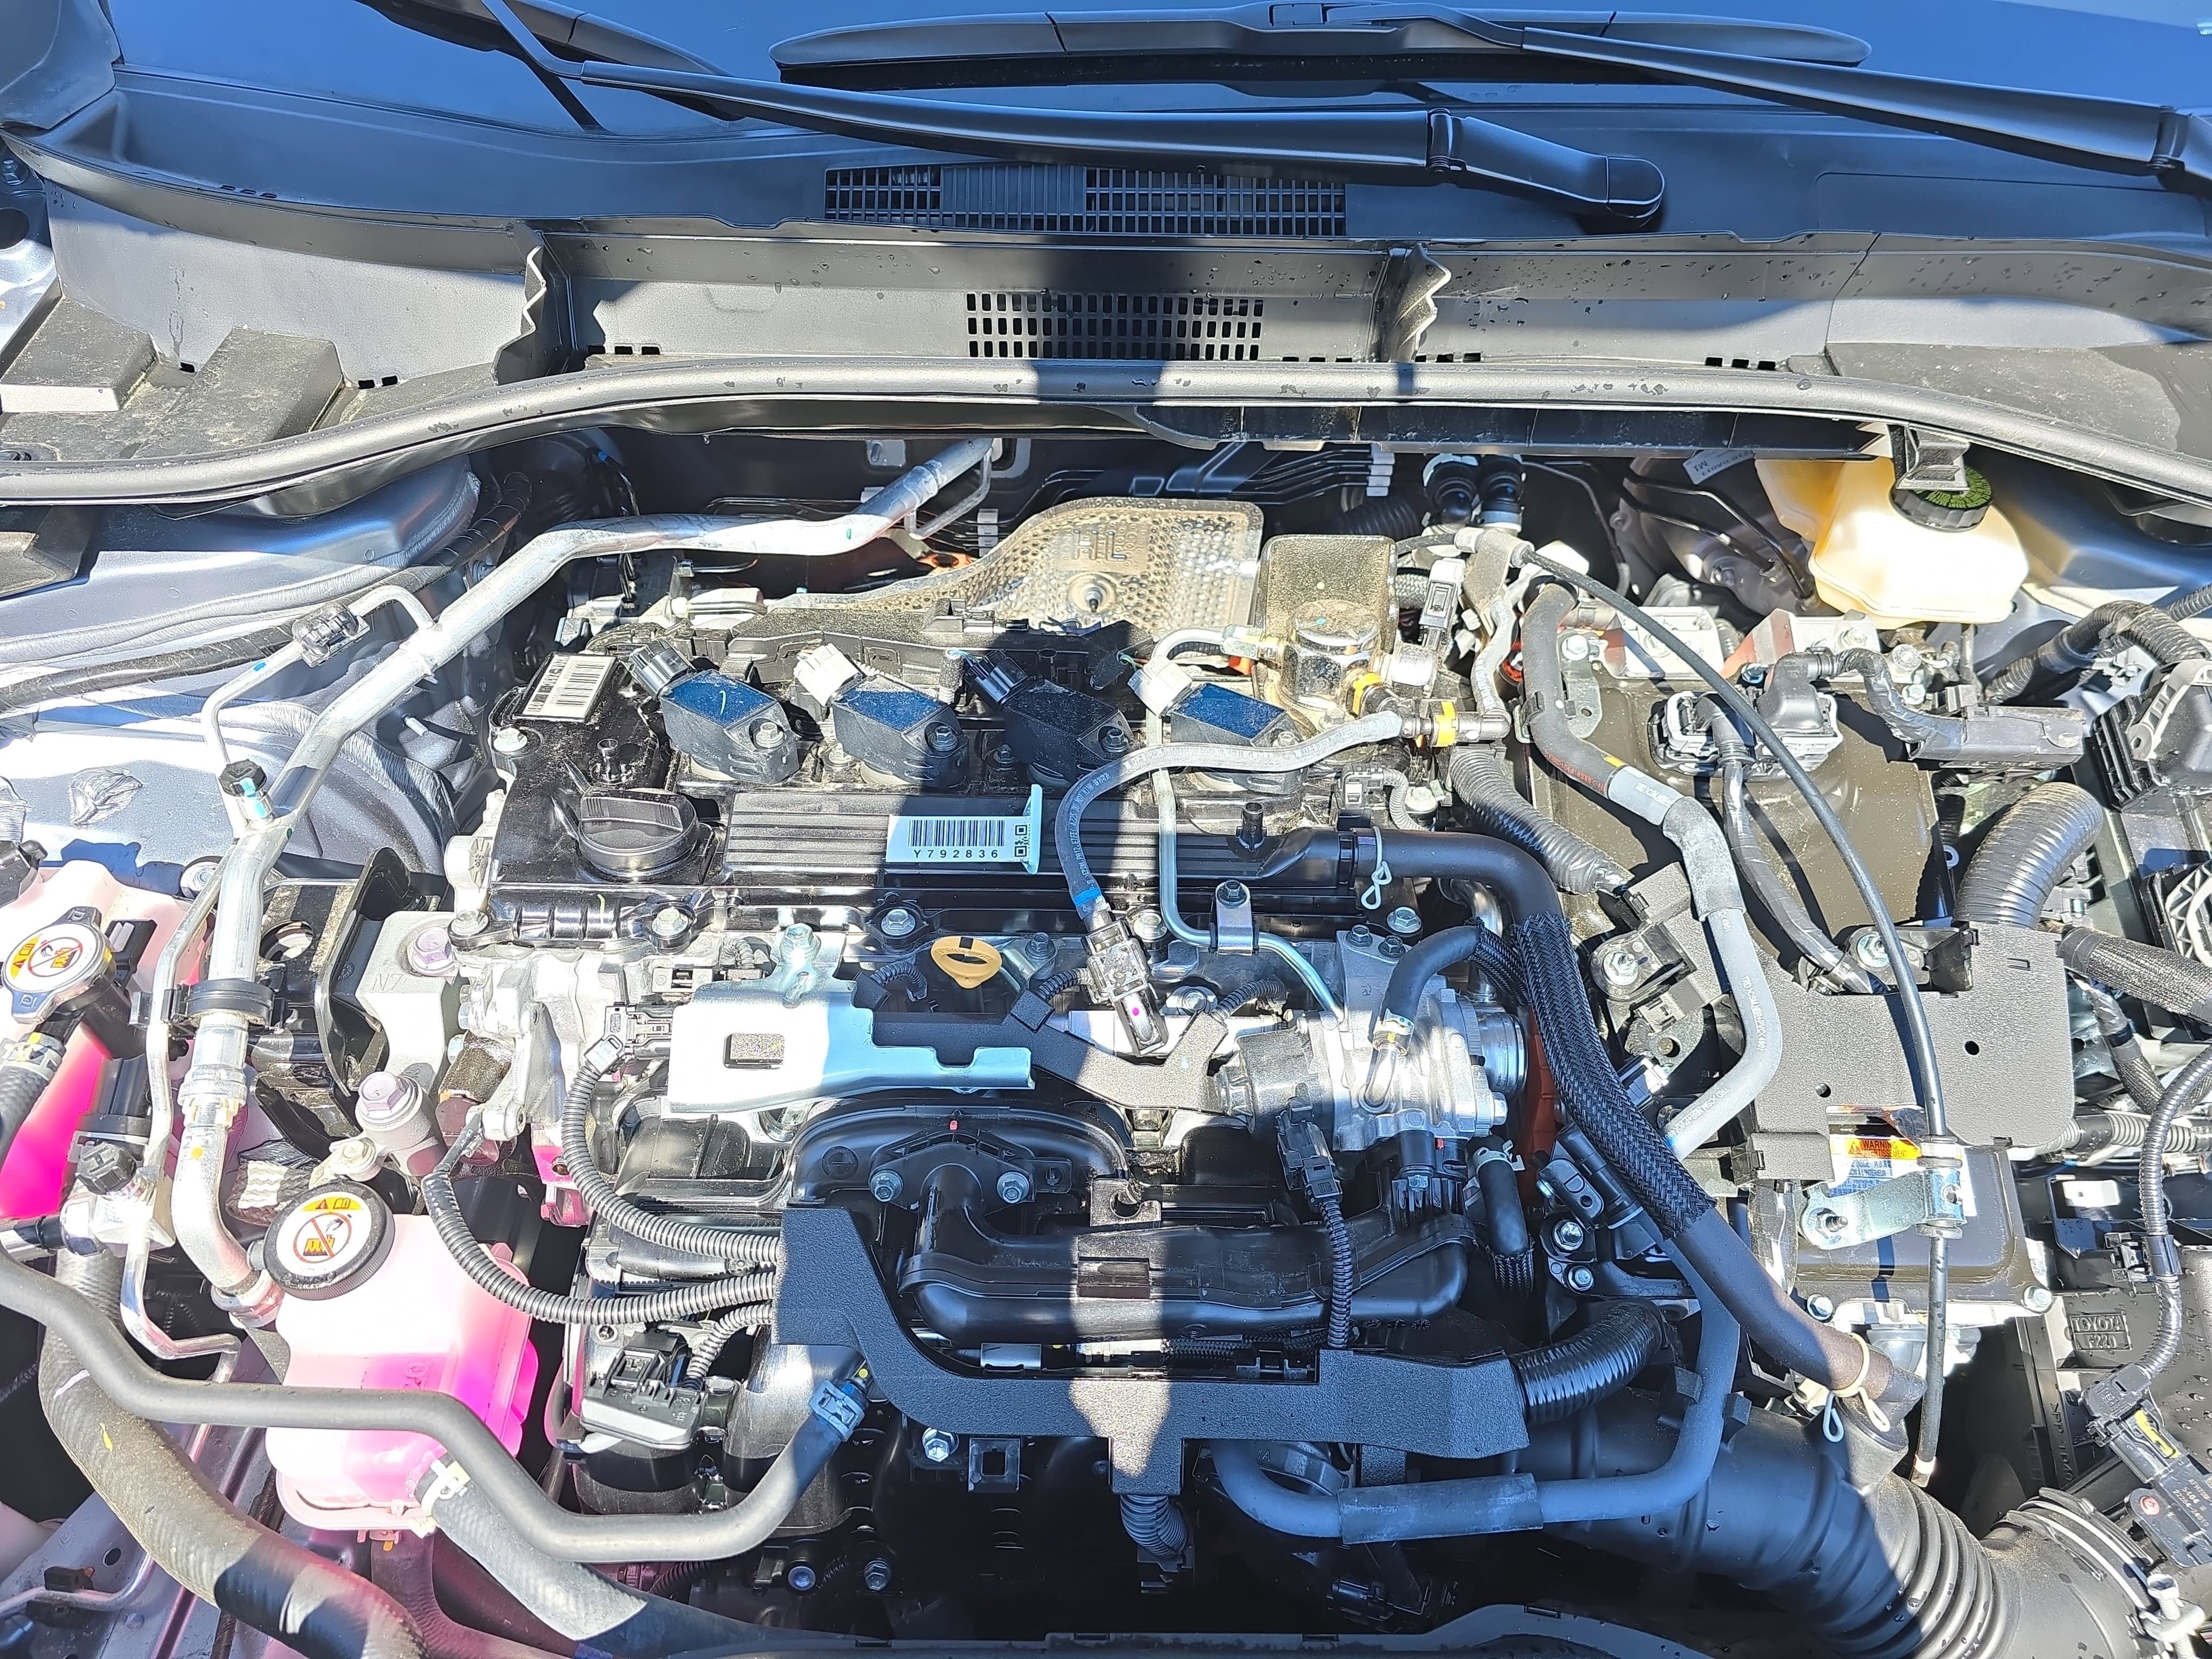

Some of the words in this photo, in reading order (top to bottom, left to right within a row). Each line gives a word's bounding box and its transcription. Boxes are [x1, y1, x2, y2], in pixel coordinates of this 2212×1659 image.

[914, 849, 998, 858] Y792836
[1862, 1139, 1898, 1149] WARNING
[2071, 1315, 2124, 1332] TOYOTA
